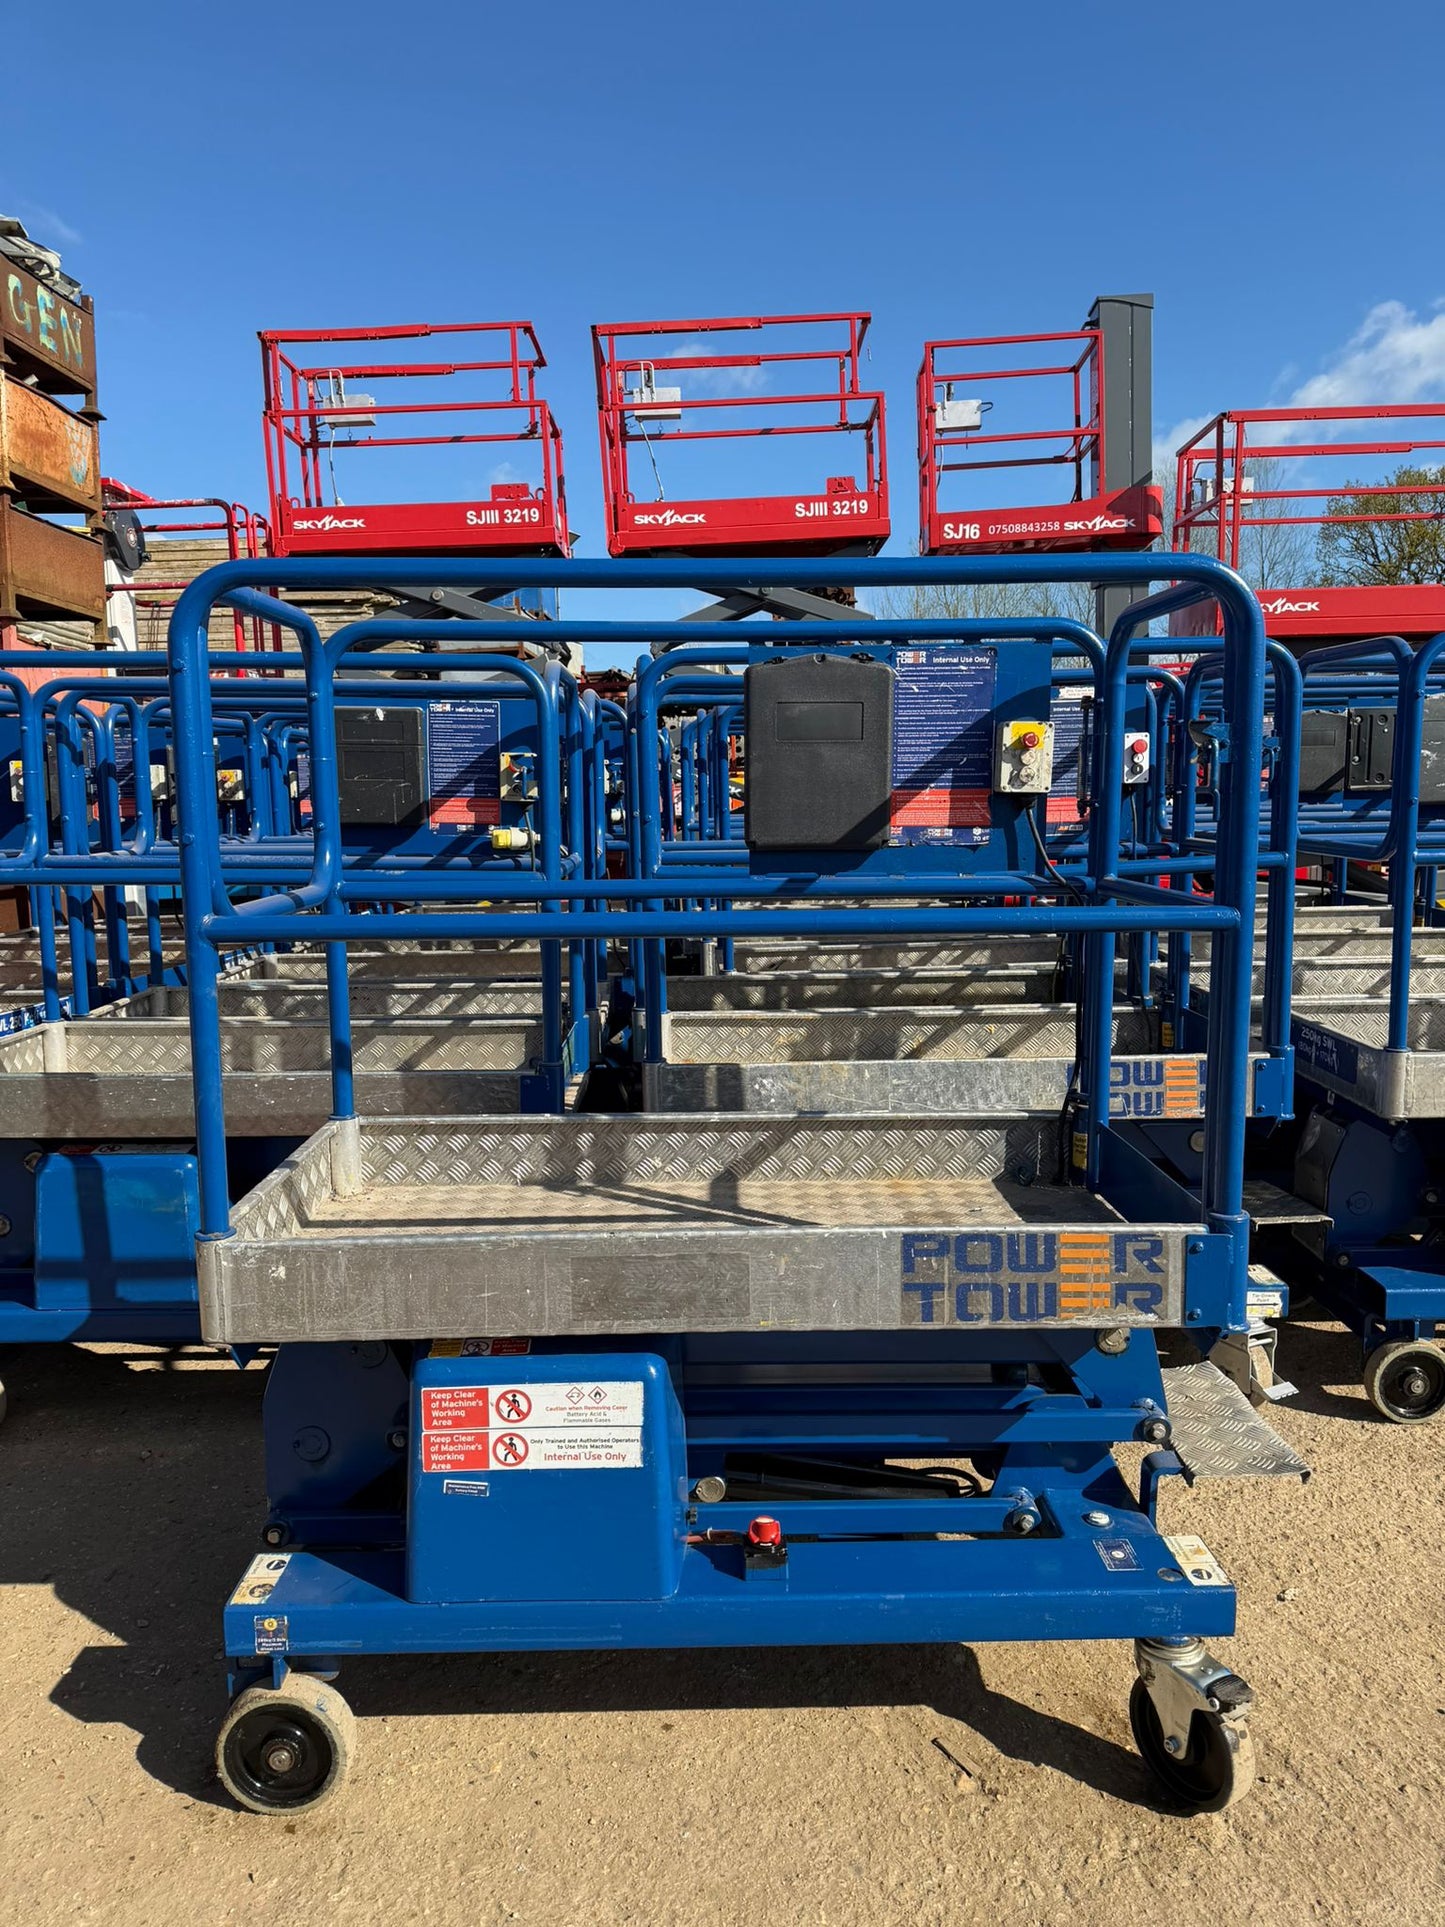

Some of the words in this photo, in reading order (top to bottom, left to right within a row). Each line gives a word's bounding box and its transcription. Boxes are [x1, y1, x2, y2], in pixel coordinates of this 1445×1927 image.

[7, 272, 84, 368] GEN
[832, 498, 869, 516] 3219
[503, 507, 540, 525] 3219
[634, 508, 707, 526] SKYJACK
[292, 514, 366, 532] SKYJACK
[943, 523, 980, 540] SJ16
[988, 521, 1061, 536] 07508843258
[1063, 514, 1137, 531] SKYJACK
[932, 656, 959, 664] Internal
[960, 656, 973, 664] Use
[974, 656, 990, 664] Only
[902, 1233, 1164, 1274] POWER
[902, 1281, 1164, 1323] TOWER
[430, 1391, 452, 1400] Keep
[453, 1390, 476, 1398] Clear
[430, 1400, 440, 1408] of
[441, 1399, 483, 1408] Machine's
[431, 1408, 466, 1418] Working
[431, 1418, 453, 1426] Area
[430, 1435, 452, 1444] Keep
[453, 1434, 476, 1442] Clear
[430, 1443, 439, 1452] of
[440, 1443, 483, 1452] Machine's
[430, 1452, 465, 1462] Working
[543, 1452, 582, 1461] Internal
[584, 1451, 602, 1461] Use
[604, 1452, 627, 1462] Only
[430, 1462, 452, 1470] Area
